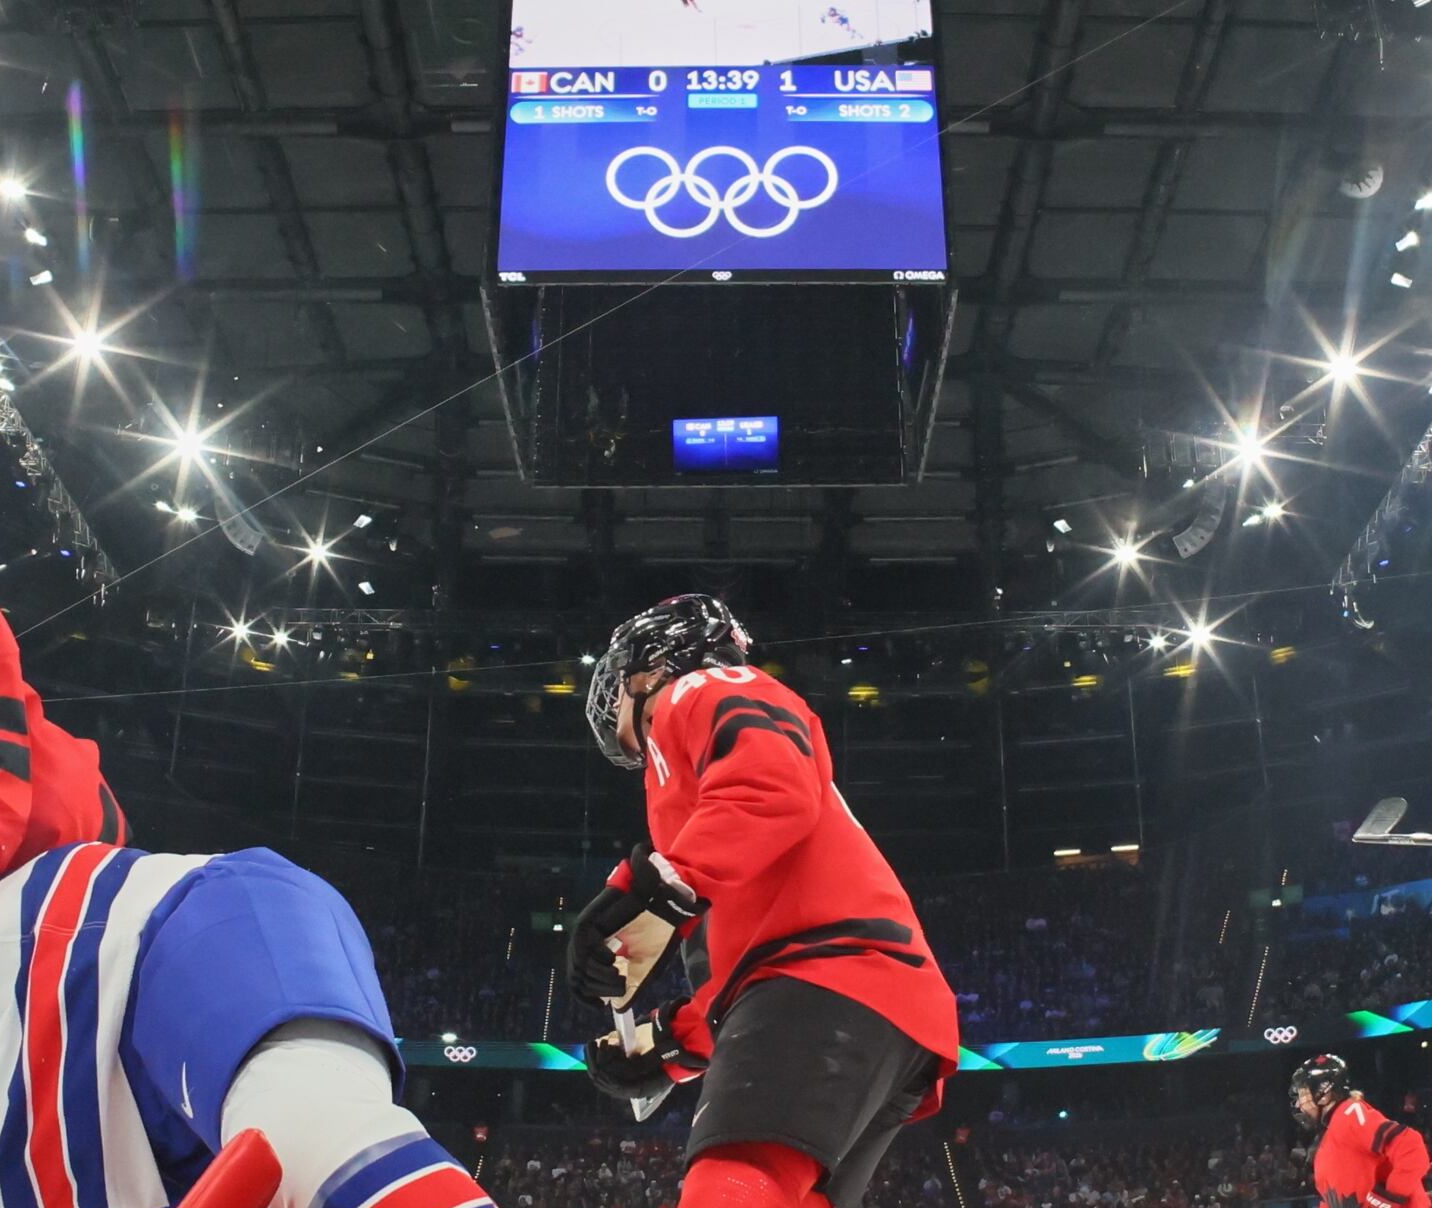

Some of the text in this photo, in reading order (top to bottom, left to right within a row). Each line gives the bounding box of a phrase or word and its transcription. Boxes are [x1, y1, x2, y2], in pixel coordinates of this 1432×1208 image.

[550, 71, 615, 93] CAN
[648, 70, 667, 92] 0
[686, 70, 759, 91] 13:39
[779, 71, 797, 91] 1
[834, 70, 895, 92] USA
[552, 105, 604, 119] SHOTS
[839, 104, 891, 118] SHOTS
[899, 104, 911, 118] 2
[498, 271, 526, 282] TCL
[905, 270, 945, 281] OMEGA
[646, 735, 671, 788] A
